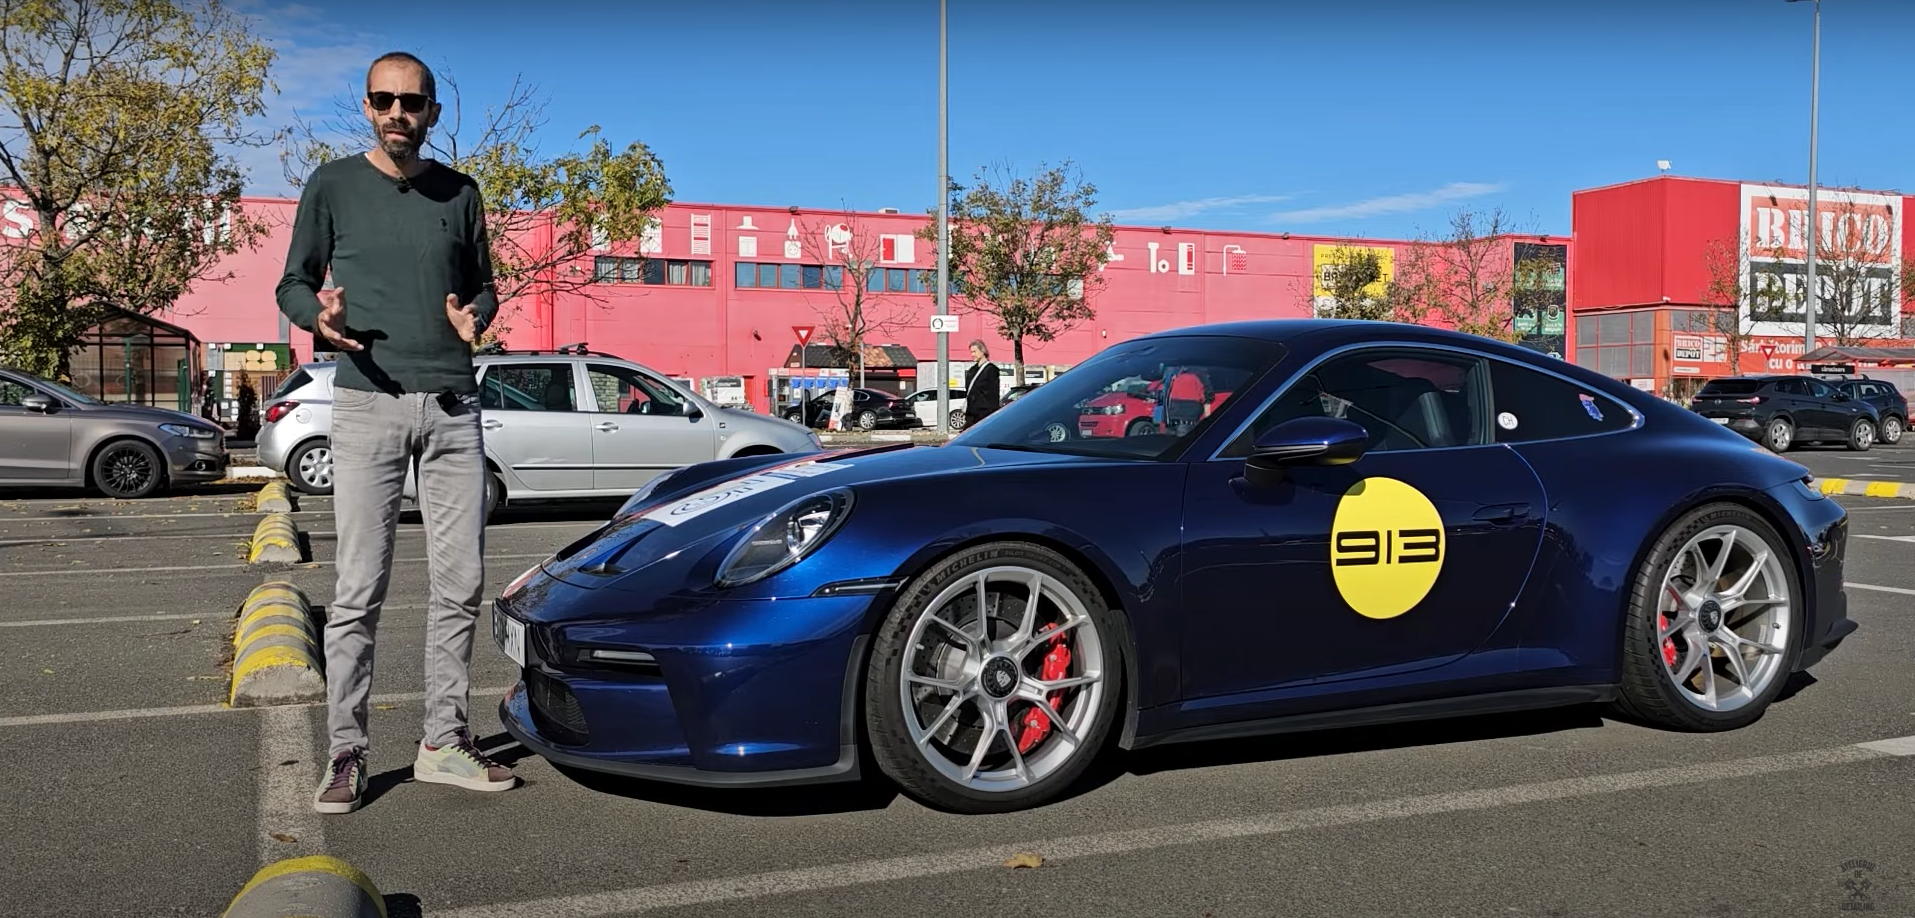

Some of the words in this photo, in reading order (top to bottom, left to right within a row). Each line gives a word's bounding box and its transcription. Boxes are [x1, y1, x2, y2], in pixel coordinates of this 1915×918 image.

[1756, 207, 1889, 254] BRICO
[1769, 359, 1782, 369] cu
[1785, 359, 1793, 370] o
[1502, 415, 1515, 426] CH
[1335, 528, 1440, 567] 913
[935, 550, 998, 583] MICHELIN
